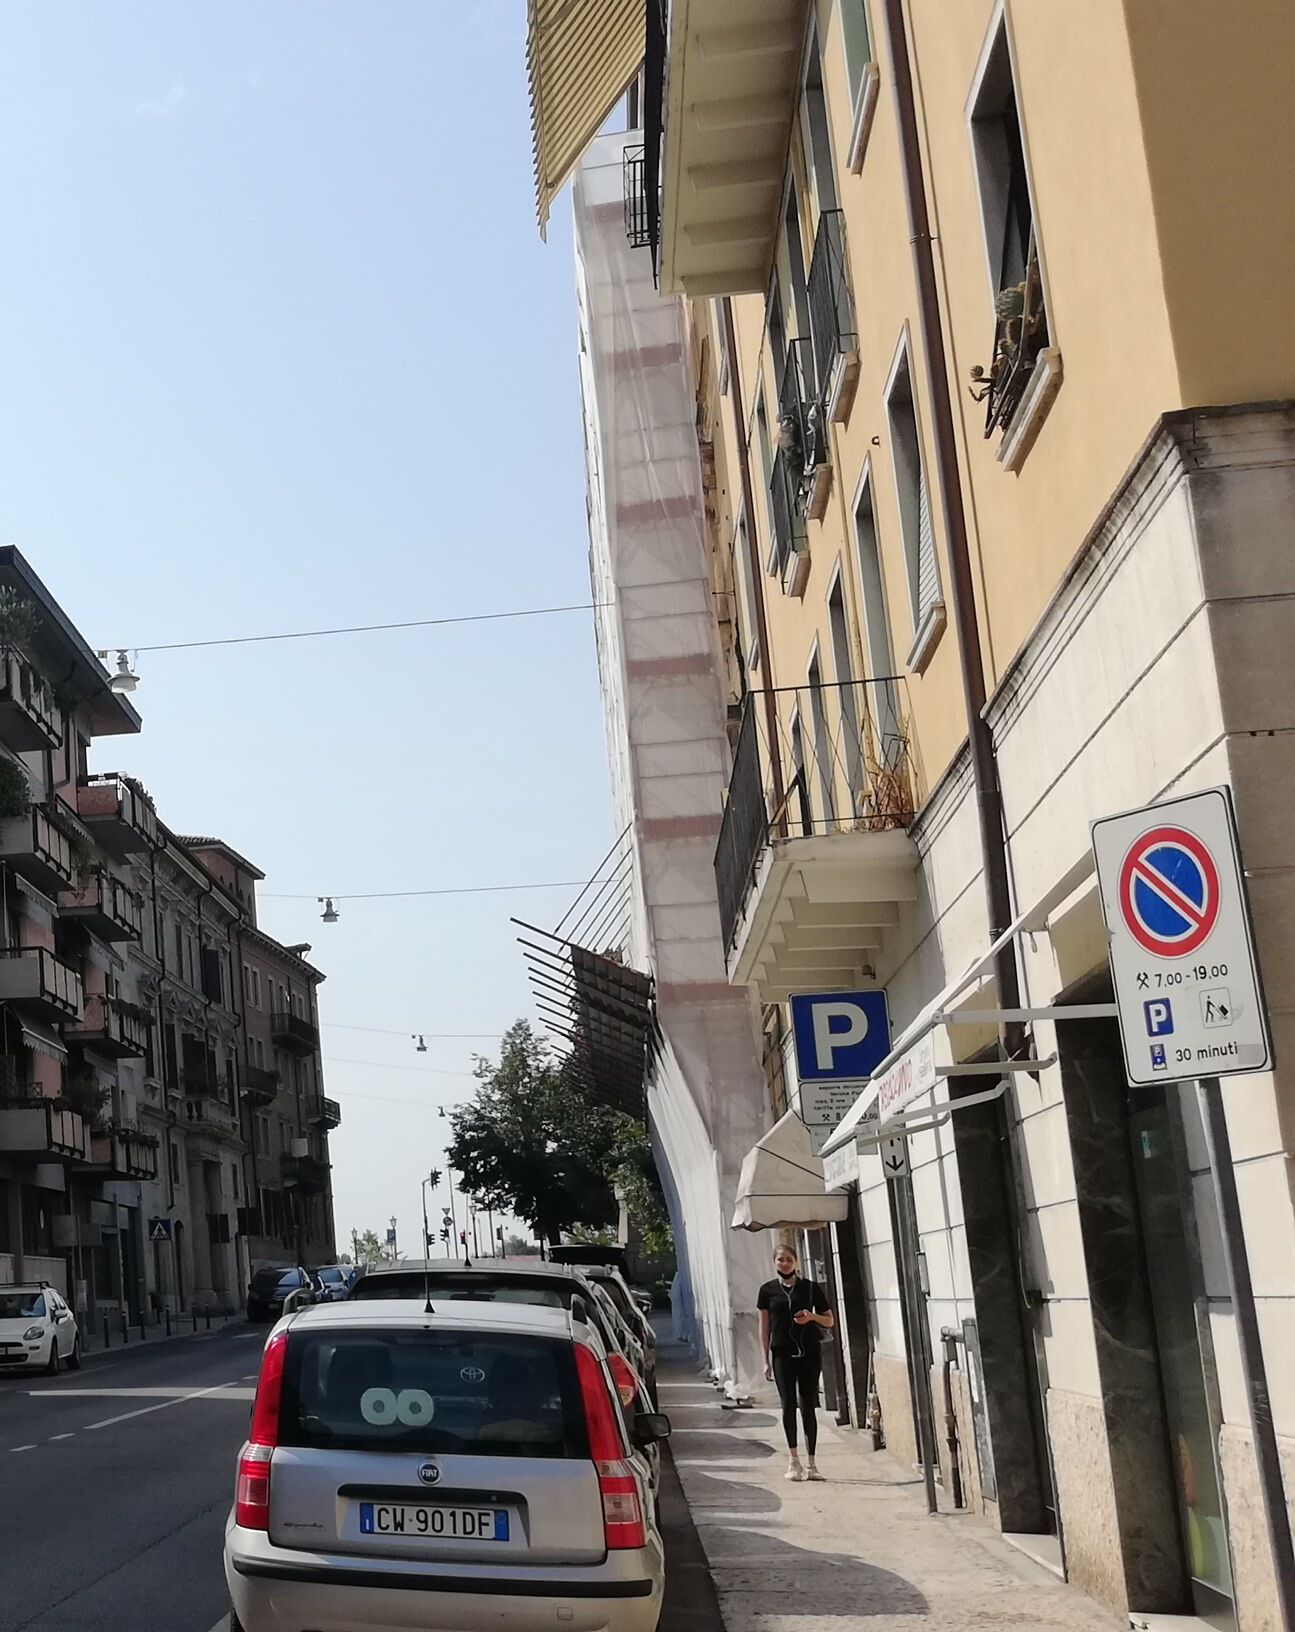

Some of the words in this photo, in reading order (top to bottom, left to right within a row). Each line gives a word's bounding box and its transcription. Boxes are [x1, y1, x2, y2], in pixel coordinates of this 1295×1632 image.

[1149, 1003, 1167, 1032] P
[811, 1002, 868, 1069] P
[1175, 1048, 1191, 1061] 30
[1197, 1041, 1238, 1060] minuti
[421, 1469, 437, 1477] FIAT
[377, 1507, 405, 1532] CW
[415, 1509, 491, 1537] 901DF
